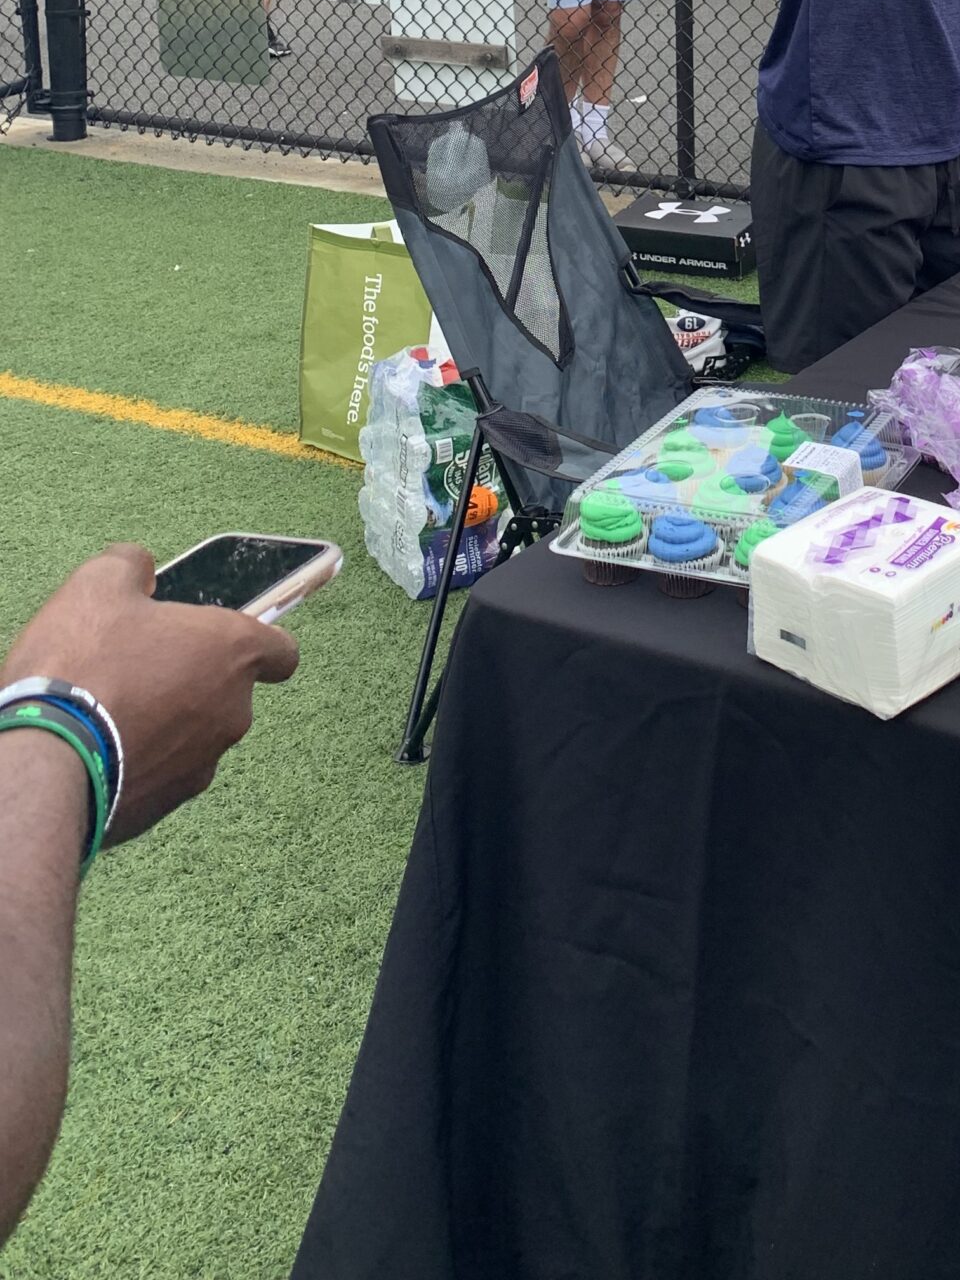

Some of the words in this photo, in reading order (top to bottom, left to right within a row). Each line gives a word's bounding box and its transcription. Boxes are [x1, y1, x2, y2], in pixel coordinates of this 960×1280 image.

[639, 253, 677, 265] UNDER
[679, 258, 728, 270] ARMOUR
[363, 273, 383, 313] The
[357, 315, 379, 373] food's
[346, 375, 369, 425] here.
